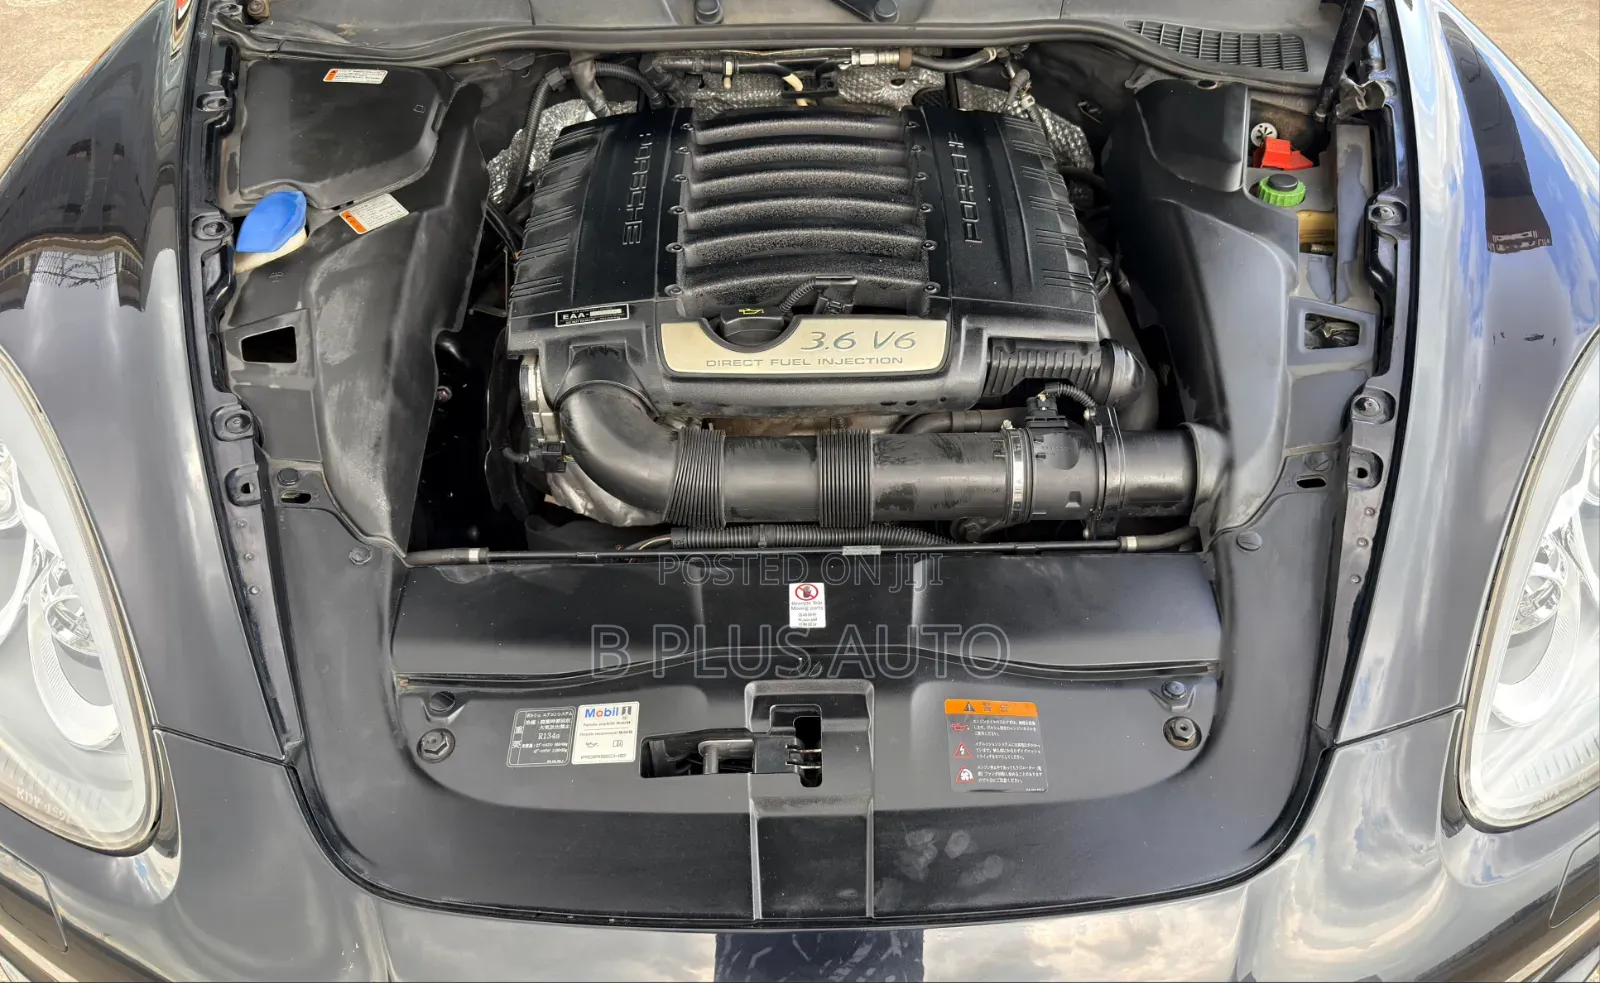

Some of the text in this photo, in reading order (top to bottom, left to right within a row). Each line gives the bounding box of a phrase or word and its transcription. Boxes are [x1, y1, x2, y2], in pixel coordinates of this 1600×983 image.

[800, 330, 916, 350] 3.6 V6
[706, 357, 903, 367] DIRECT FUEL INJECTION
[584, 707, 619, 718] Mobil
[538, 732, 560, 740] R134a
